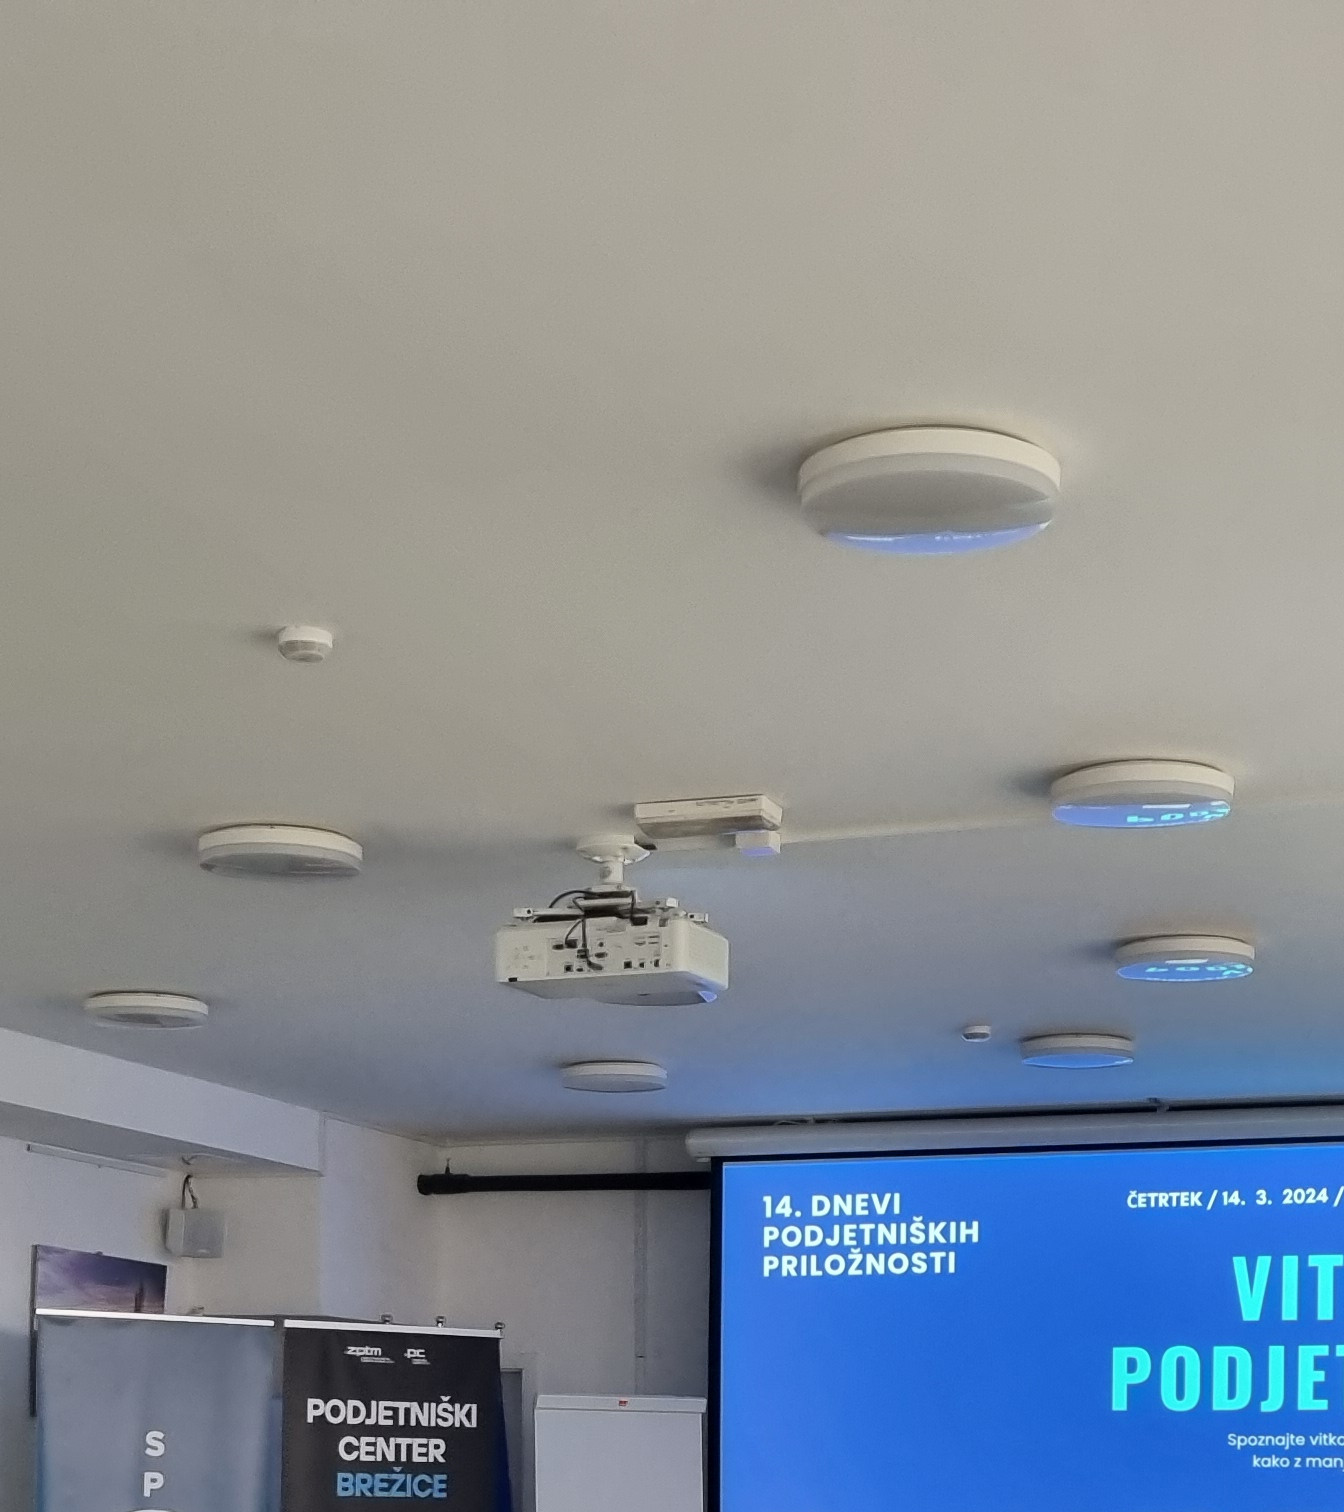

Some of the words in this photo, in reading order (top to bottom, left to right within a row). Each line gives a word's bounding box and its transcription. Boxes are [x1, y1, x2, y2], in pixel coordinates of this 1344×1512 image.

[762, 1195, 802, 1219] 14.
[811, 1192, 901, 1217] DNEVI
[1126, 1190, 1203, 1209] ČETRTEK
[1221, 1190, 1246, 1206] 14.
[1255, 1189, 1273, 1206] 3.
[1282, 1187, 1329, 1205] 2024
[763, 1216, 979, 1248] PODJETNIŠKIH
[763, 1248, 956, 1277] PRILOŽNOSTI
[306, 1395, 478, 1428] PODJETNIŠKI
[338, 1435, 446, 1463] CENTER
[1227, 1432, 1306, 1450] Spoznajte
[1252, 1454, 1291, 1468] kako
[1293, 1457, 1302, 1468] z
[336, 1466, 448, 1499] BREŽICE
